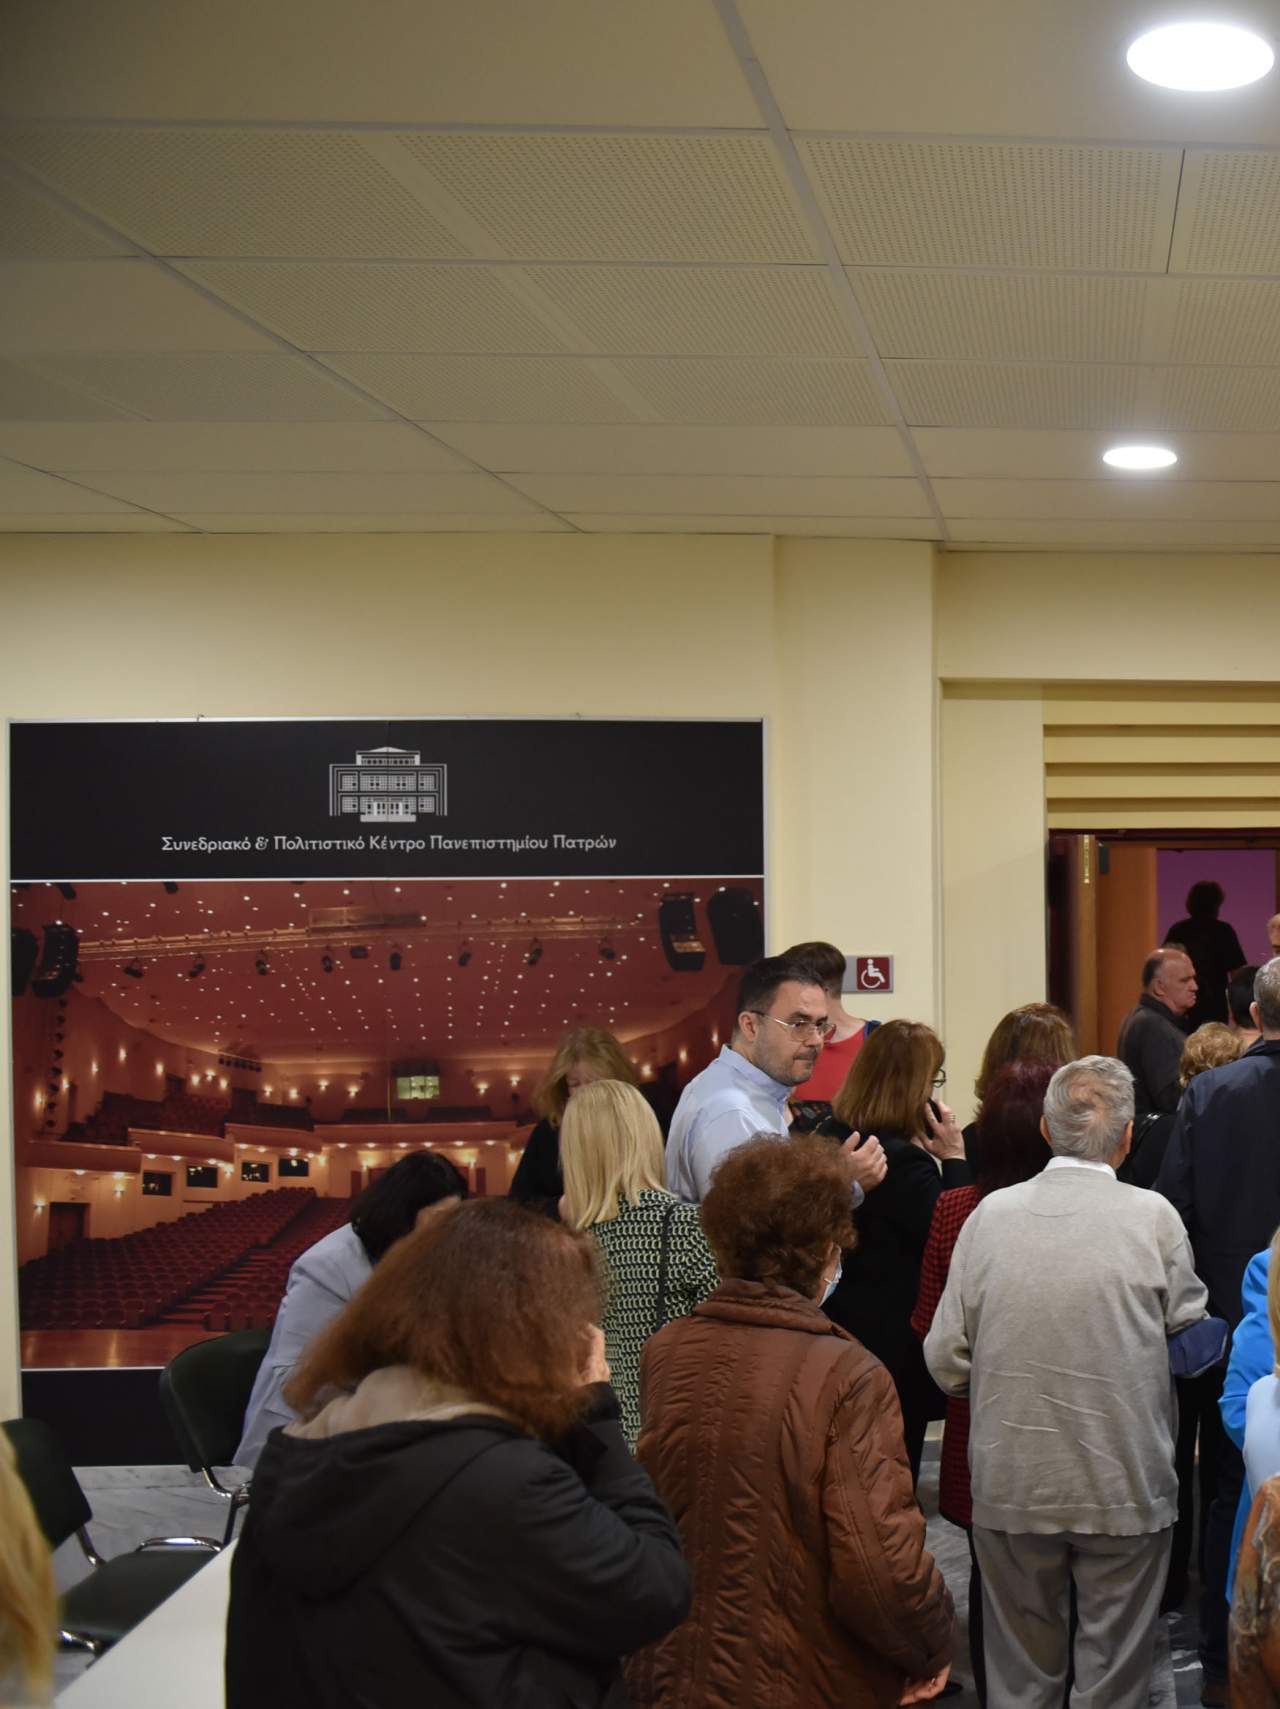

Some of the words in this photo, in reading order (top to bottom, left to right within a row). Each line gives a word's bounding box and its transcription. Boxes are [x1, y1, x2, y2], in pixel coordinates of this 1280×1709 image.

[161, 836, 251, 853] Συνεδριακό
[255, 836, 269, 850] &
[273, 835, 365, 850] Πολιτιστικό
[369, 835, 425, 852] Κέντρο
[429, 834, 548, 852] Πανεπιστημίου
[552, 834, 617, 852] Πατρών
